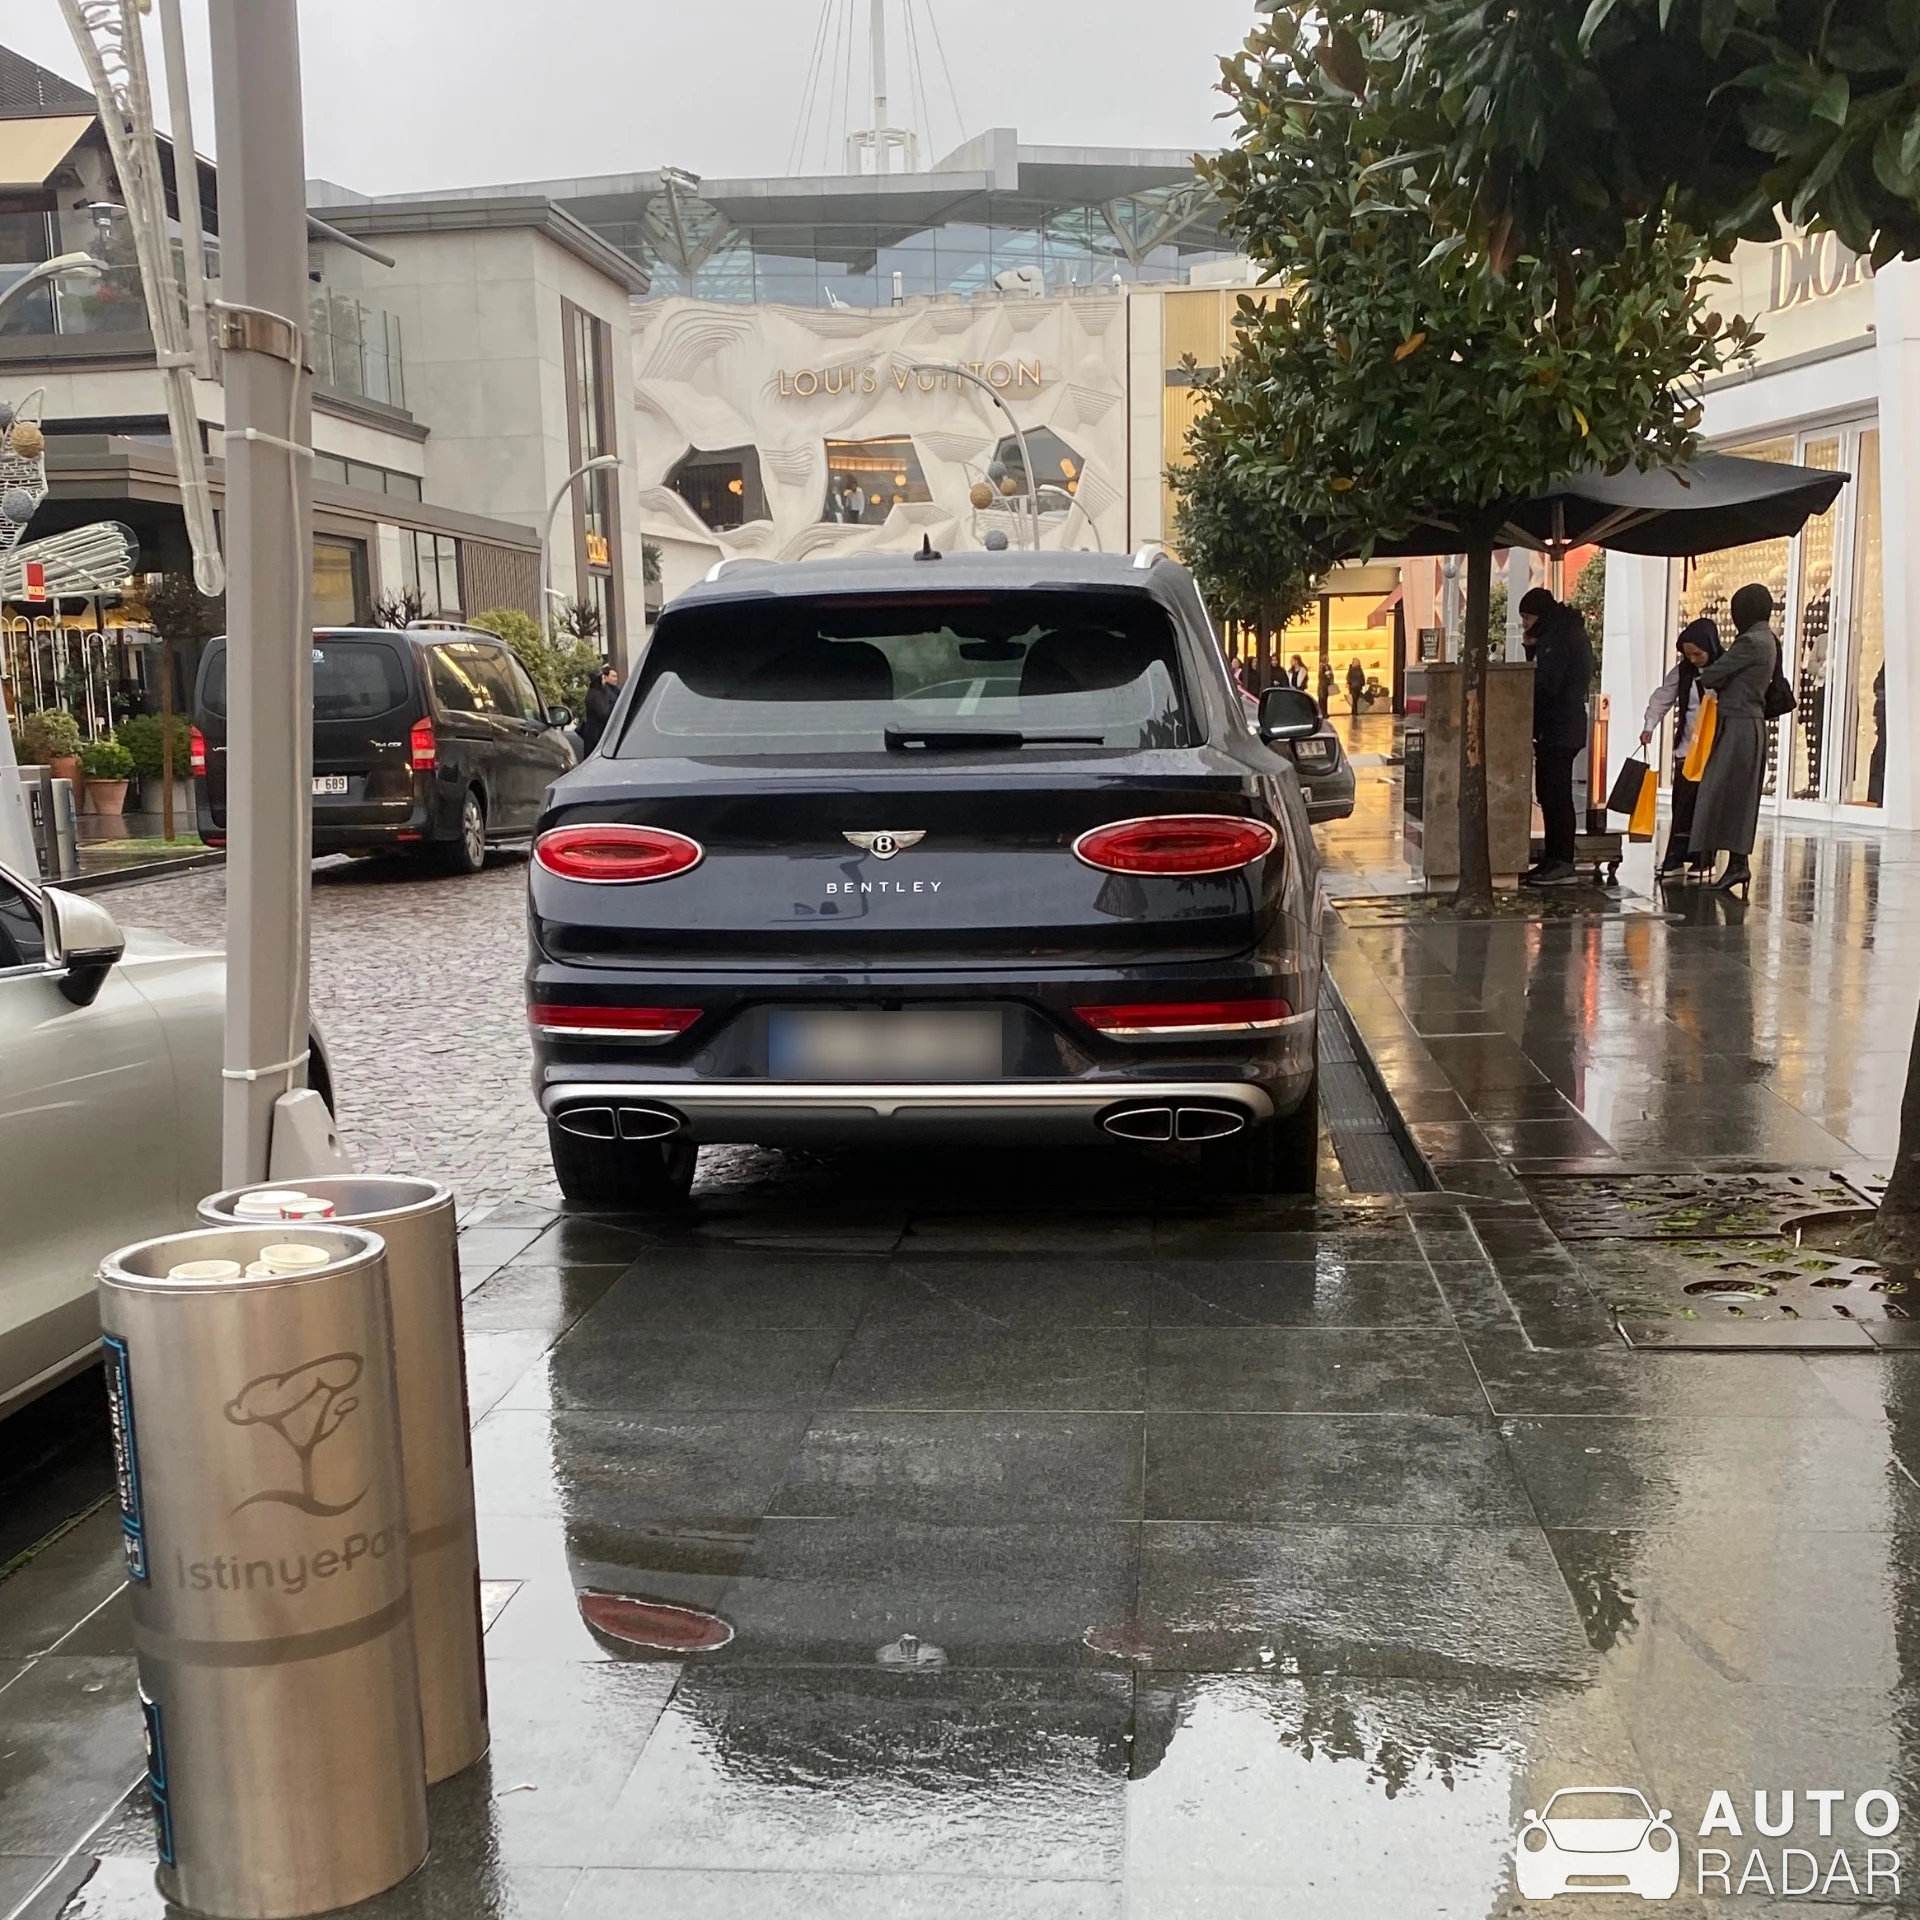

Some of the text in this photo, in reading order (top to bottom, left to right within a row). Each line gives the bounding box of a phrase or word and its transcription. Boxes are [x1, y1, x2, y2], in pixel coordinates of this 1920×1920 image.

[778, 367, 876, 396] LOUIS
[826, 881, 942, 894] BENTLEY
[175, 1523, 400, 1595] IstinyePa
